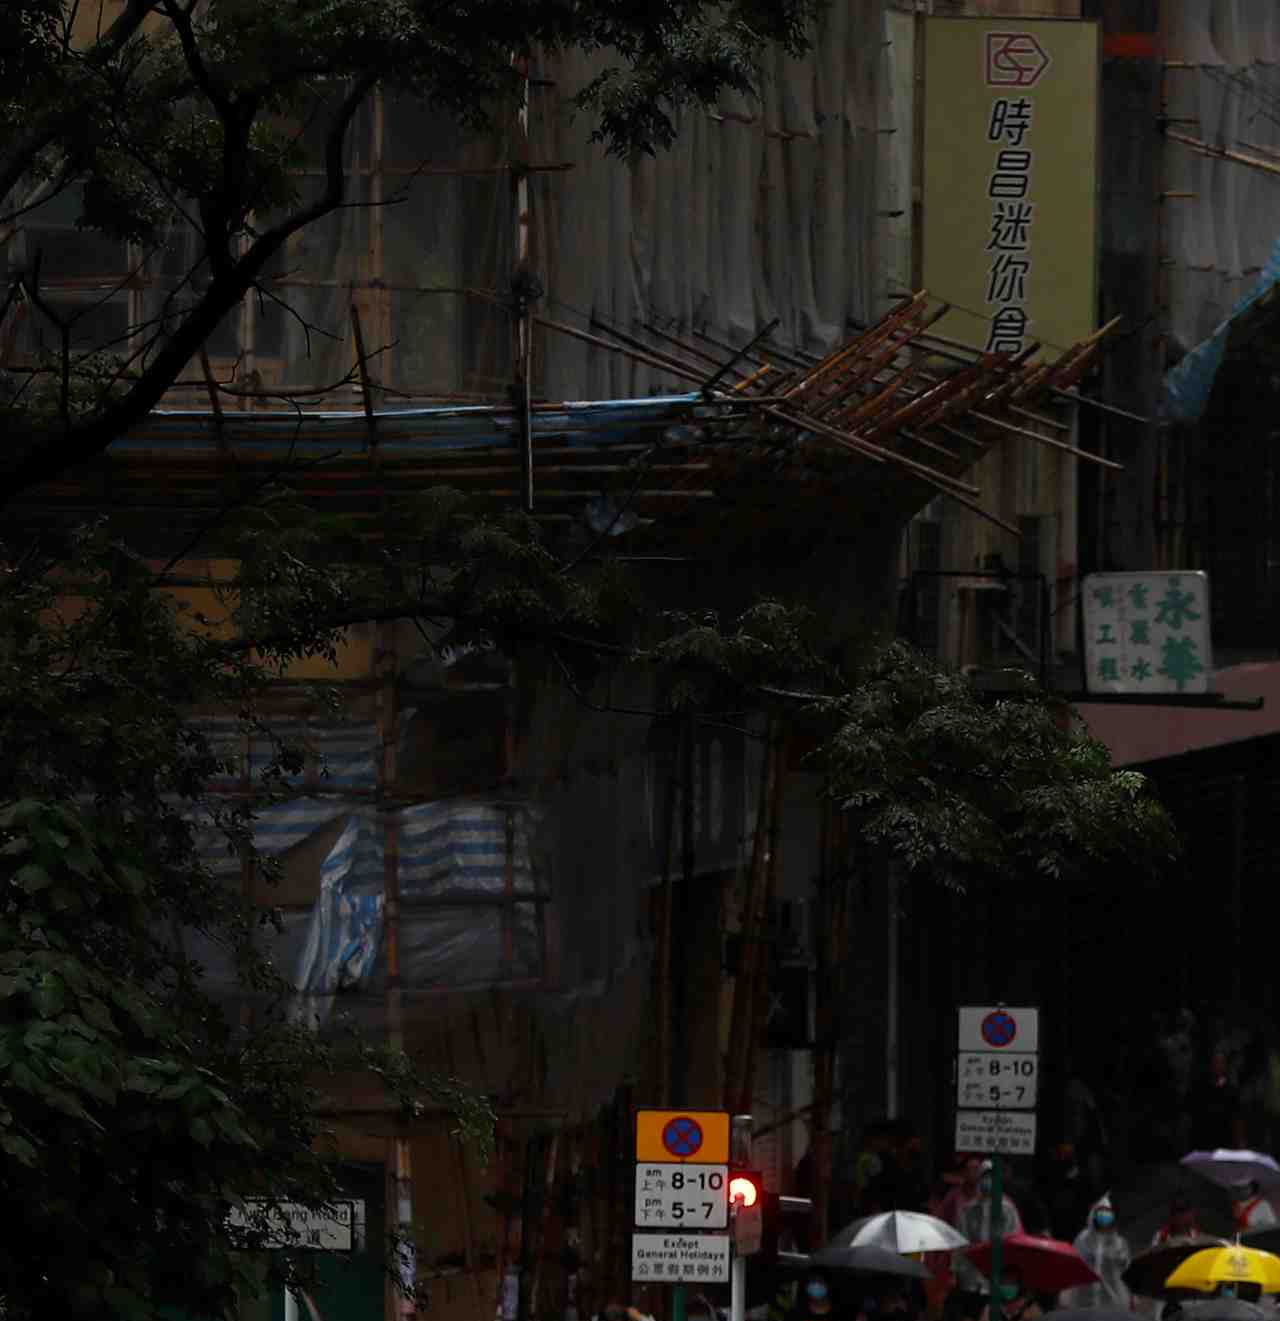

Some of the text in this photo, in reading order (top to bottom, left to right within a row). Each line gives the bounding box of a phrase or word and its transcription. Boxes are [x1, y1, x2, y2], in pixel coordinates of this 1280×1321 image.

[987, 98, 1034, 354] 時昌迷你倉
[989, 1060, 1034, 1077] 8-10
[645, 1169, 662, 1178] am
[671, 1172, 723, 1190] 8-10
[645, 1199, 662, 1209] pm
[663, 1237, 699, 1251] Except
[637, 1249, 679, 1260] General
